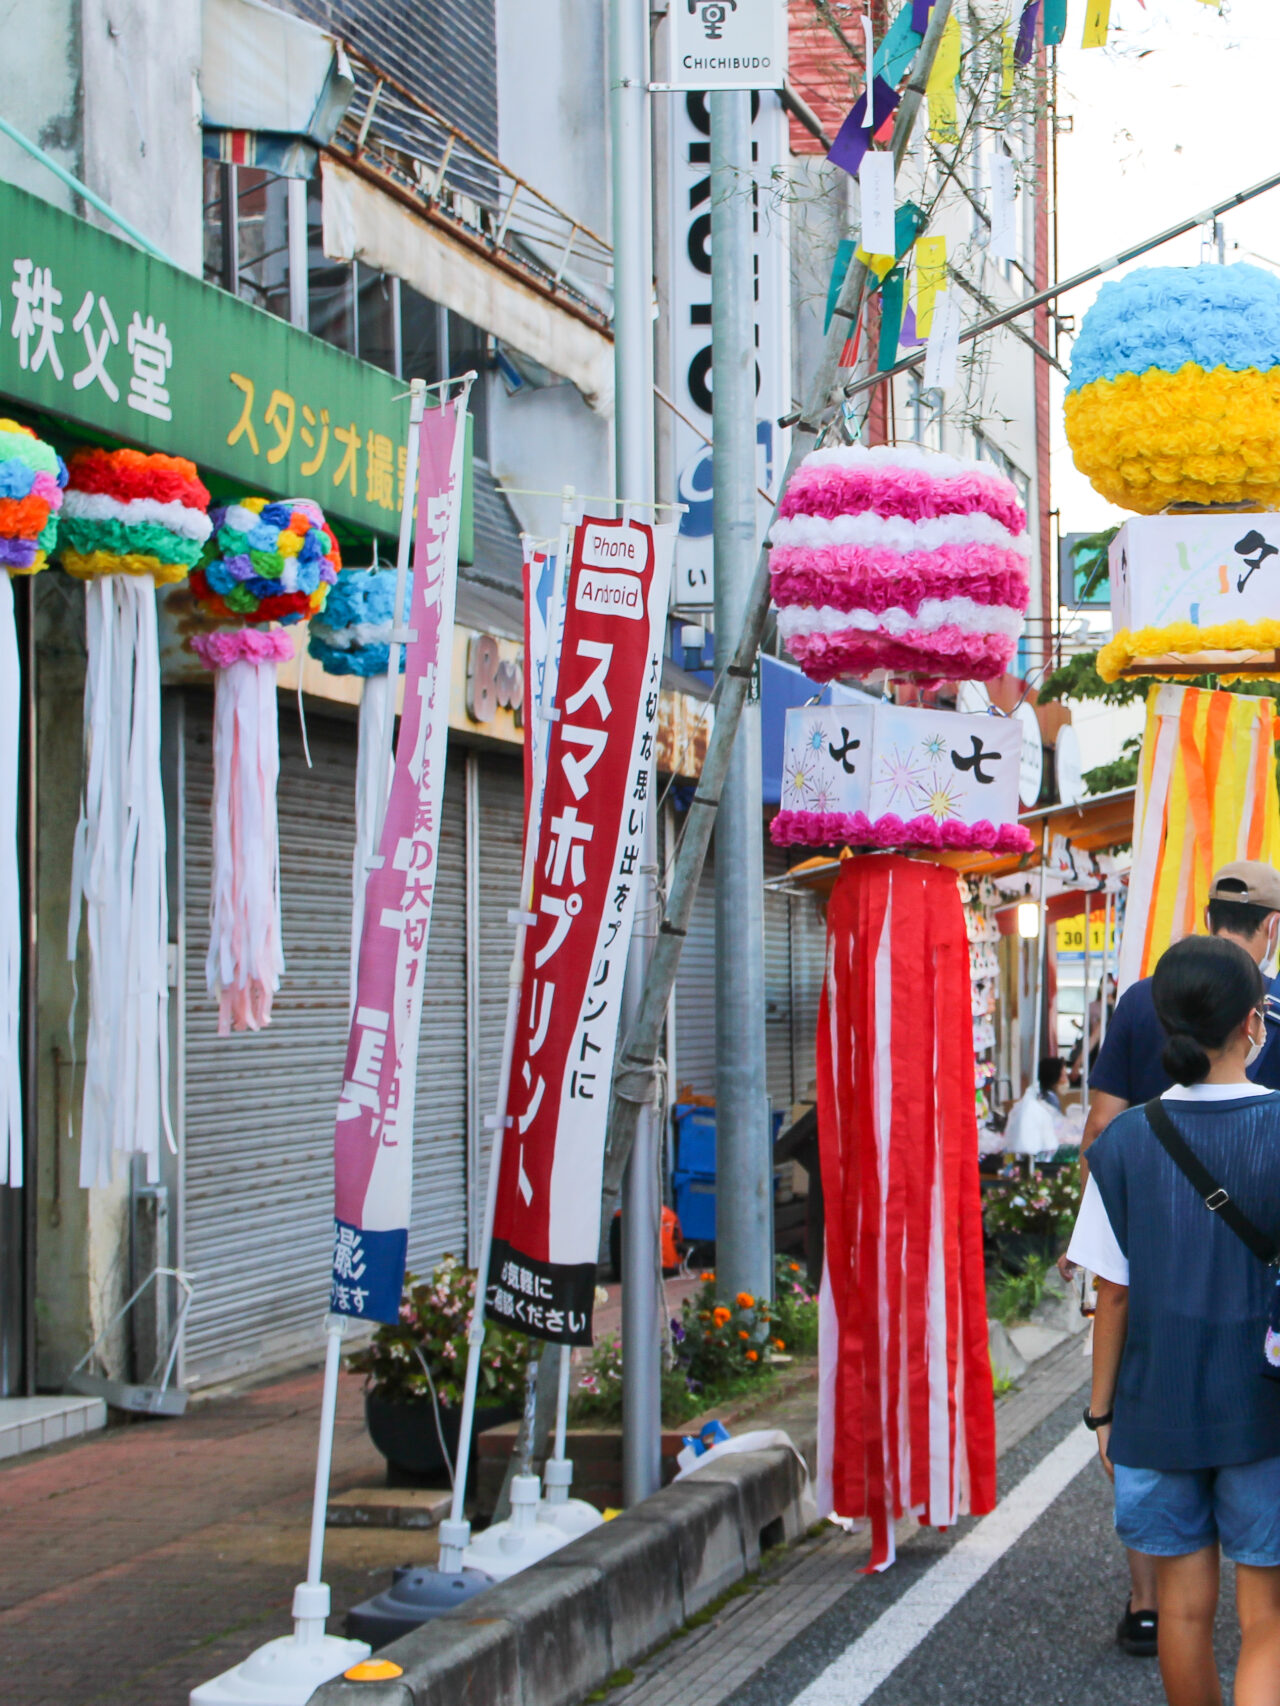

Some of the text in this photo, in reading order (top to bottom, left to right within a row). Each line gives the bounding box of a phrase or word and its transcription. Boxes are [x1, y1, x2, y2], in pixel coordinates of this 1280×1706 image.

[683, 55, 771, 69] CHICHIBUDO
[12, 258, 173, 422] 秩父堂
[950, 734, 1003, 785] 七
[517, 639, 614, 1207] スマホプリント
